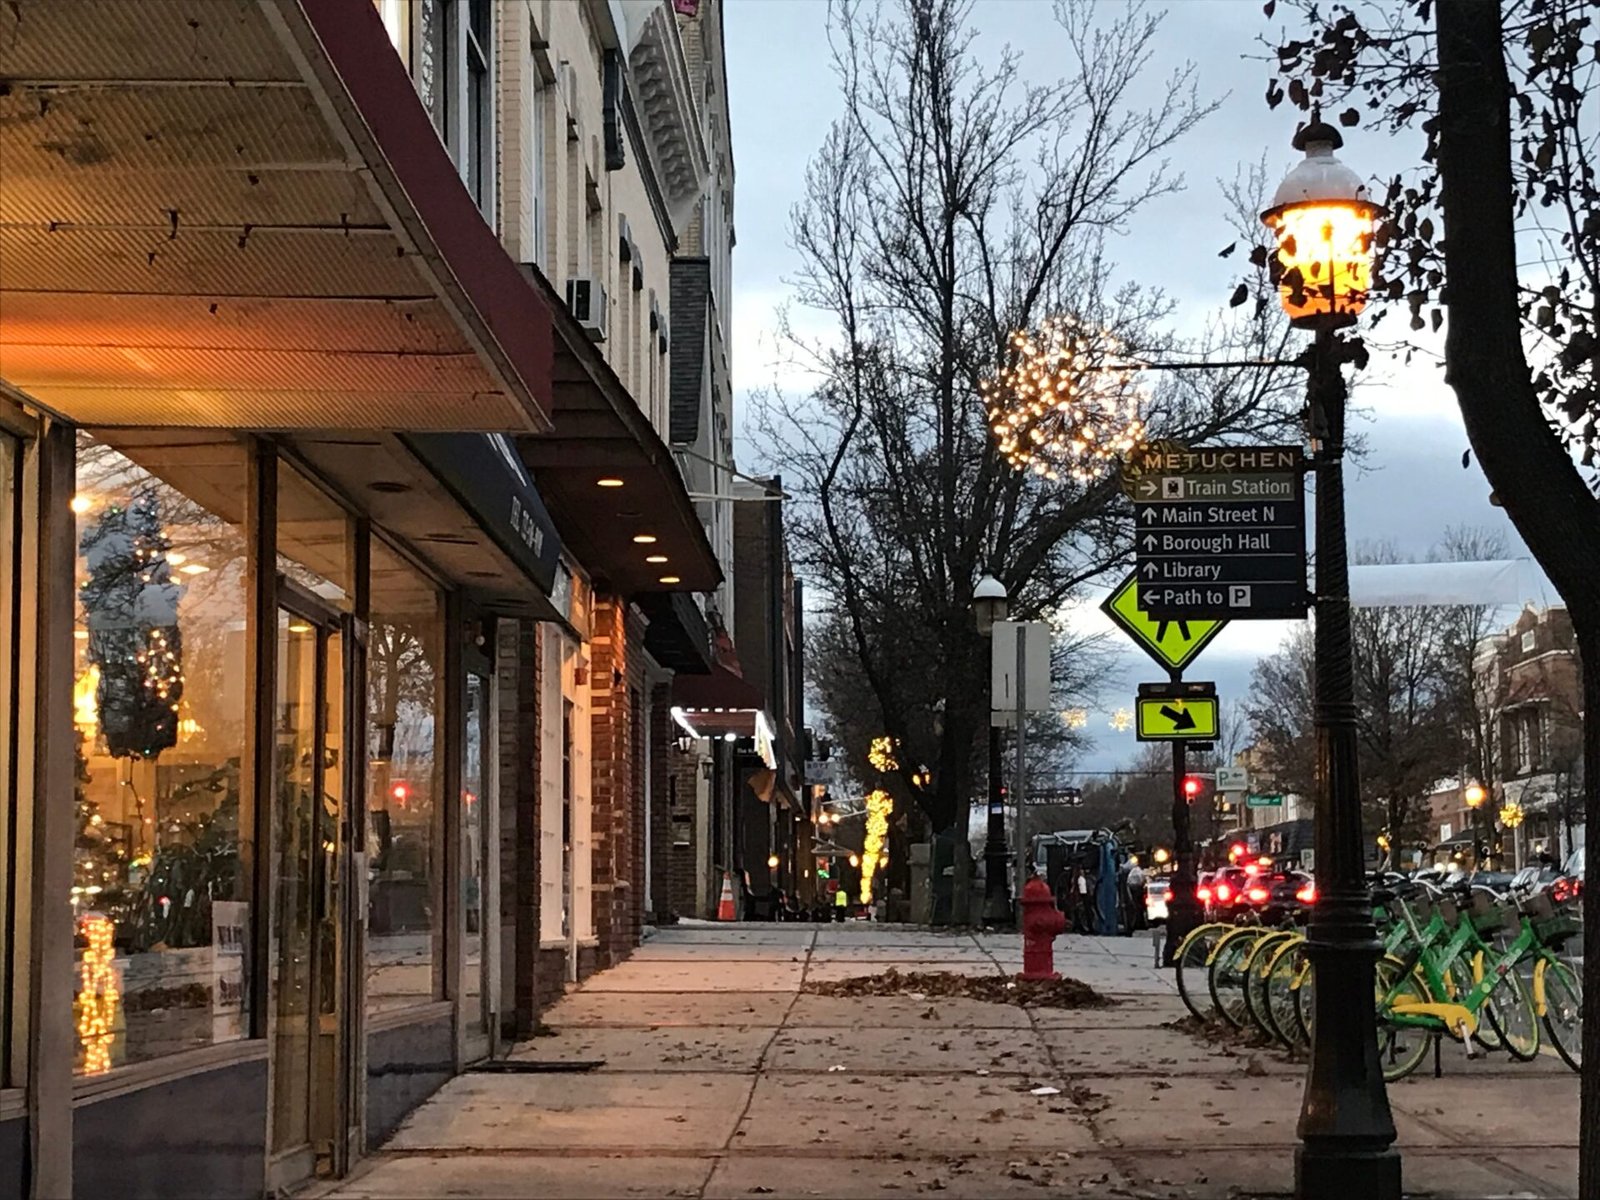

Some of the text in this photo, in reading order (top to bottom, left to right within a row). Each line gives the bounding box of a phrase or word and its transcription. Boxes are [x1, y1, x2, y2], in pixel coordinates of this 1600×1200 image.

[1145, 452, 1294, 469] METUCHEN
[1187, 480, 1291, 495] Train Station
[1162, 507, 1275, 523] Main Street N
[1163, 534, 1270, 552] Borough Hall
[1163, 563, 1221, 580] Library
[1164, 588, 1246, 604] Path to P
